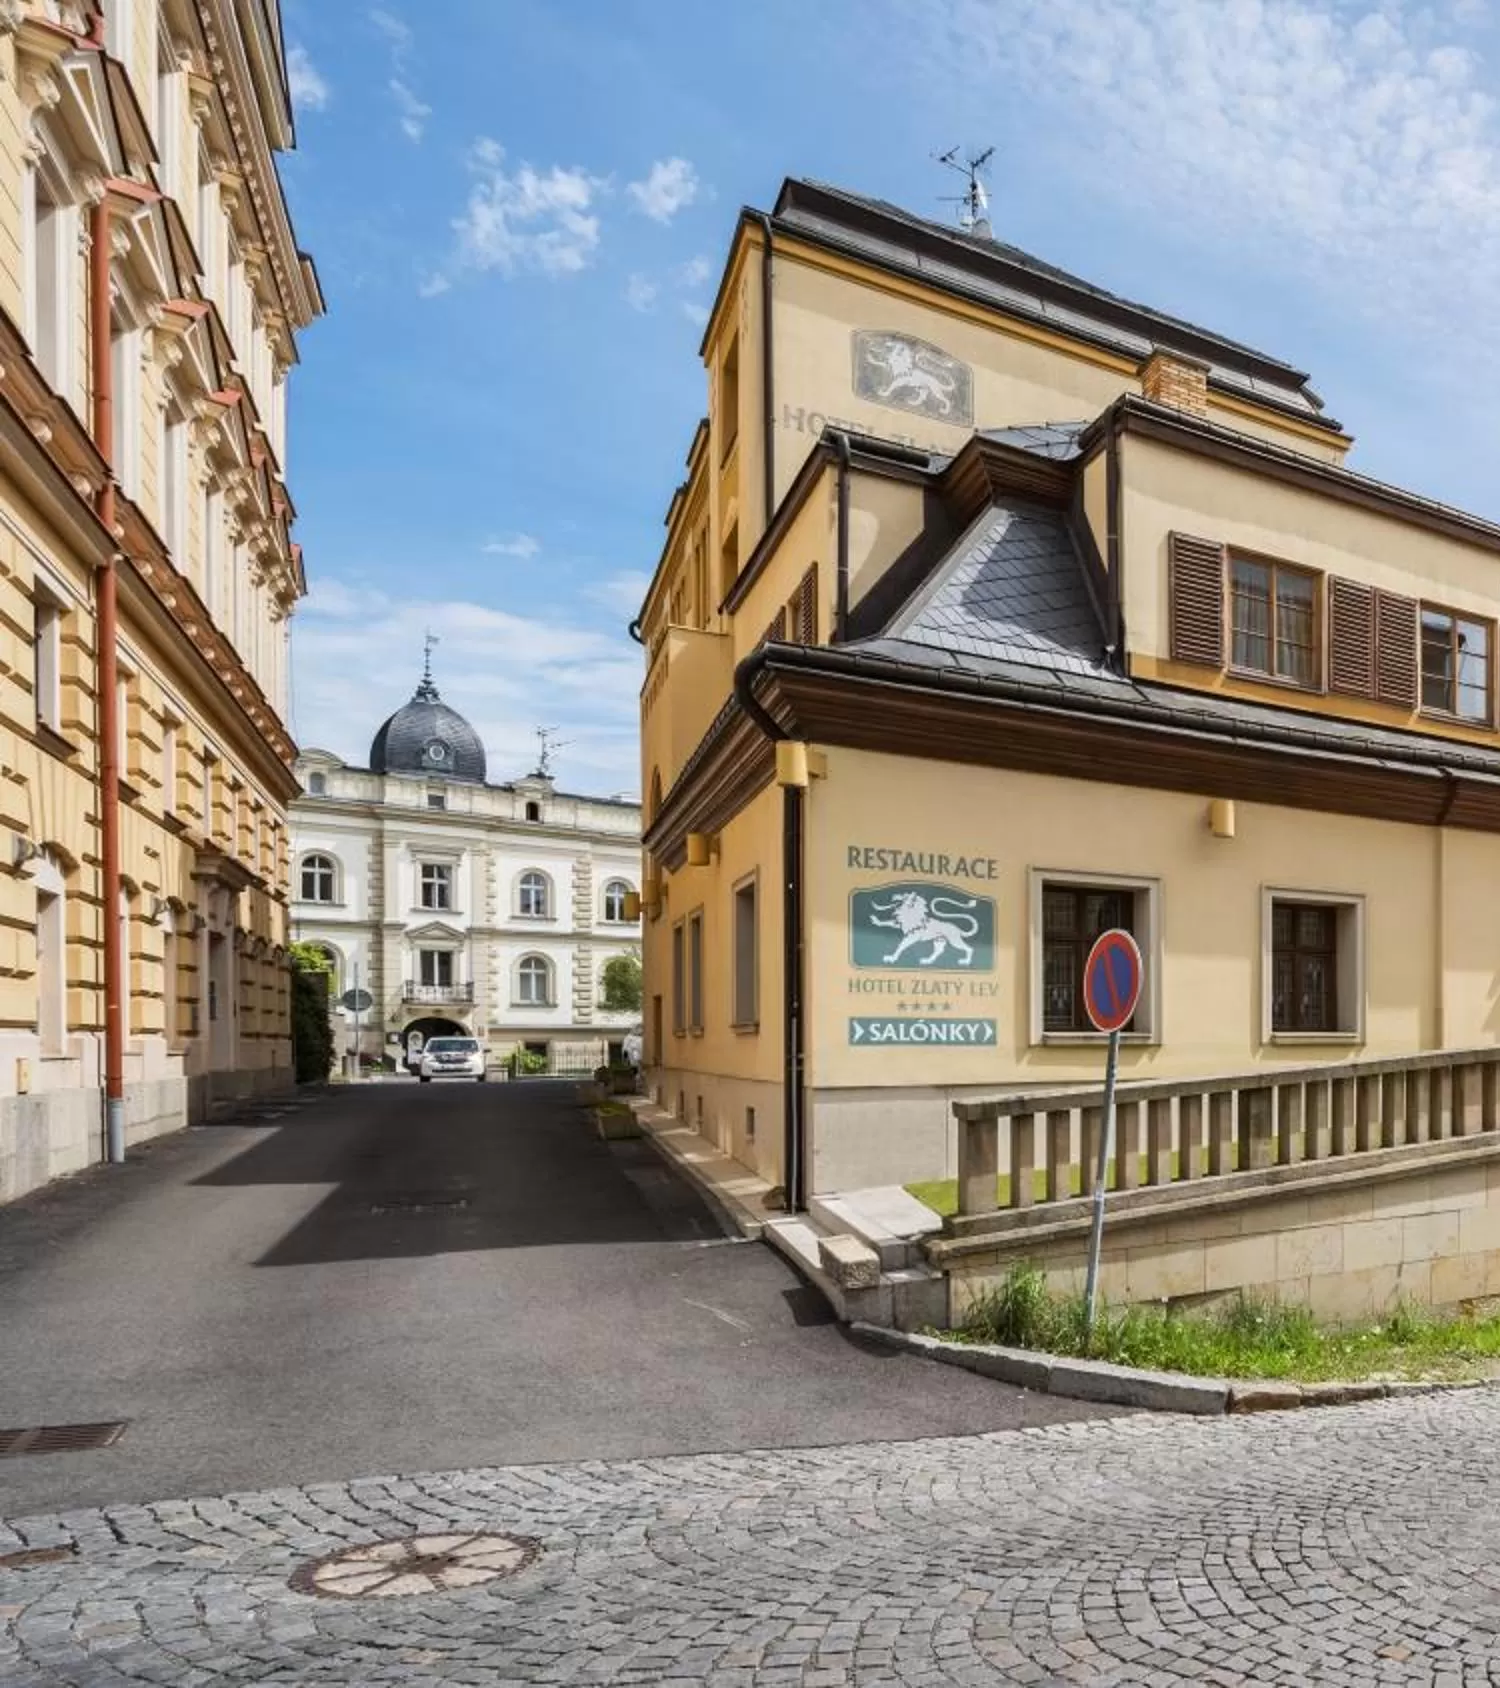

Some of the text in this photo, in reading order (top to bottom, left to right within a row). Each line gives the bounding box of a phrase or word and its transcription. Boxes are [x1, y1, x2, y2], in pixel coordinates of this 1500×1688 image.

[848, 845, 999, 880] RESTAURACE
[848, 978, 999, 997] HOTEL ZLATÝ LEV
[869, 1019, 979, 1041] SALÓNKY
